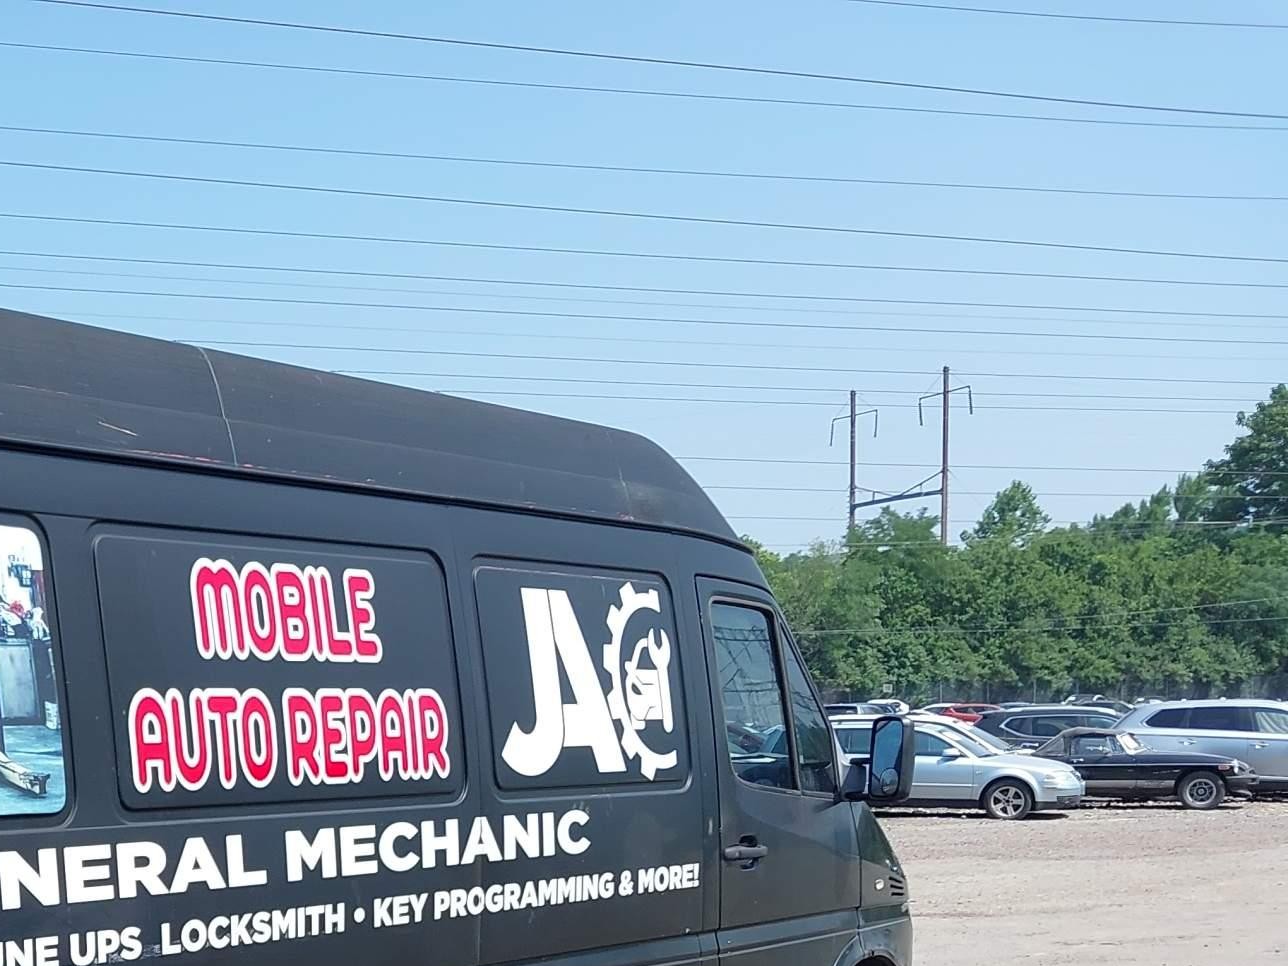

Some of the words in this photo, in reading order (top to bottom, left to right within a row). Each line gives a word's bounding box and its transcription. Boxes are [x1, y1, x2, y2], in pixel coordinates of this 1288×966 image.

[190, 557, 383, 664] MOBILE
[128, 687, 278, 794] AUTO
[281, 687, 450, 786] REPAIR
[285, 809, 591, 884] MECHANIC
[69, 926, 142, 966] UPS
[161, 902, 346, 957] LOCKSMITH
[373, 893, 429, 928] KEY
[433, 870, 614, 920] PROGRAMMING
[618, 870, 634, 896] &
[638, 862, 700, 895] MORE!
